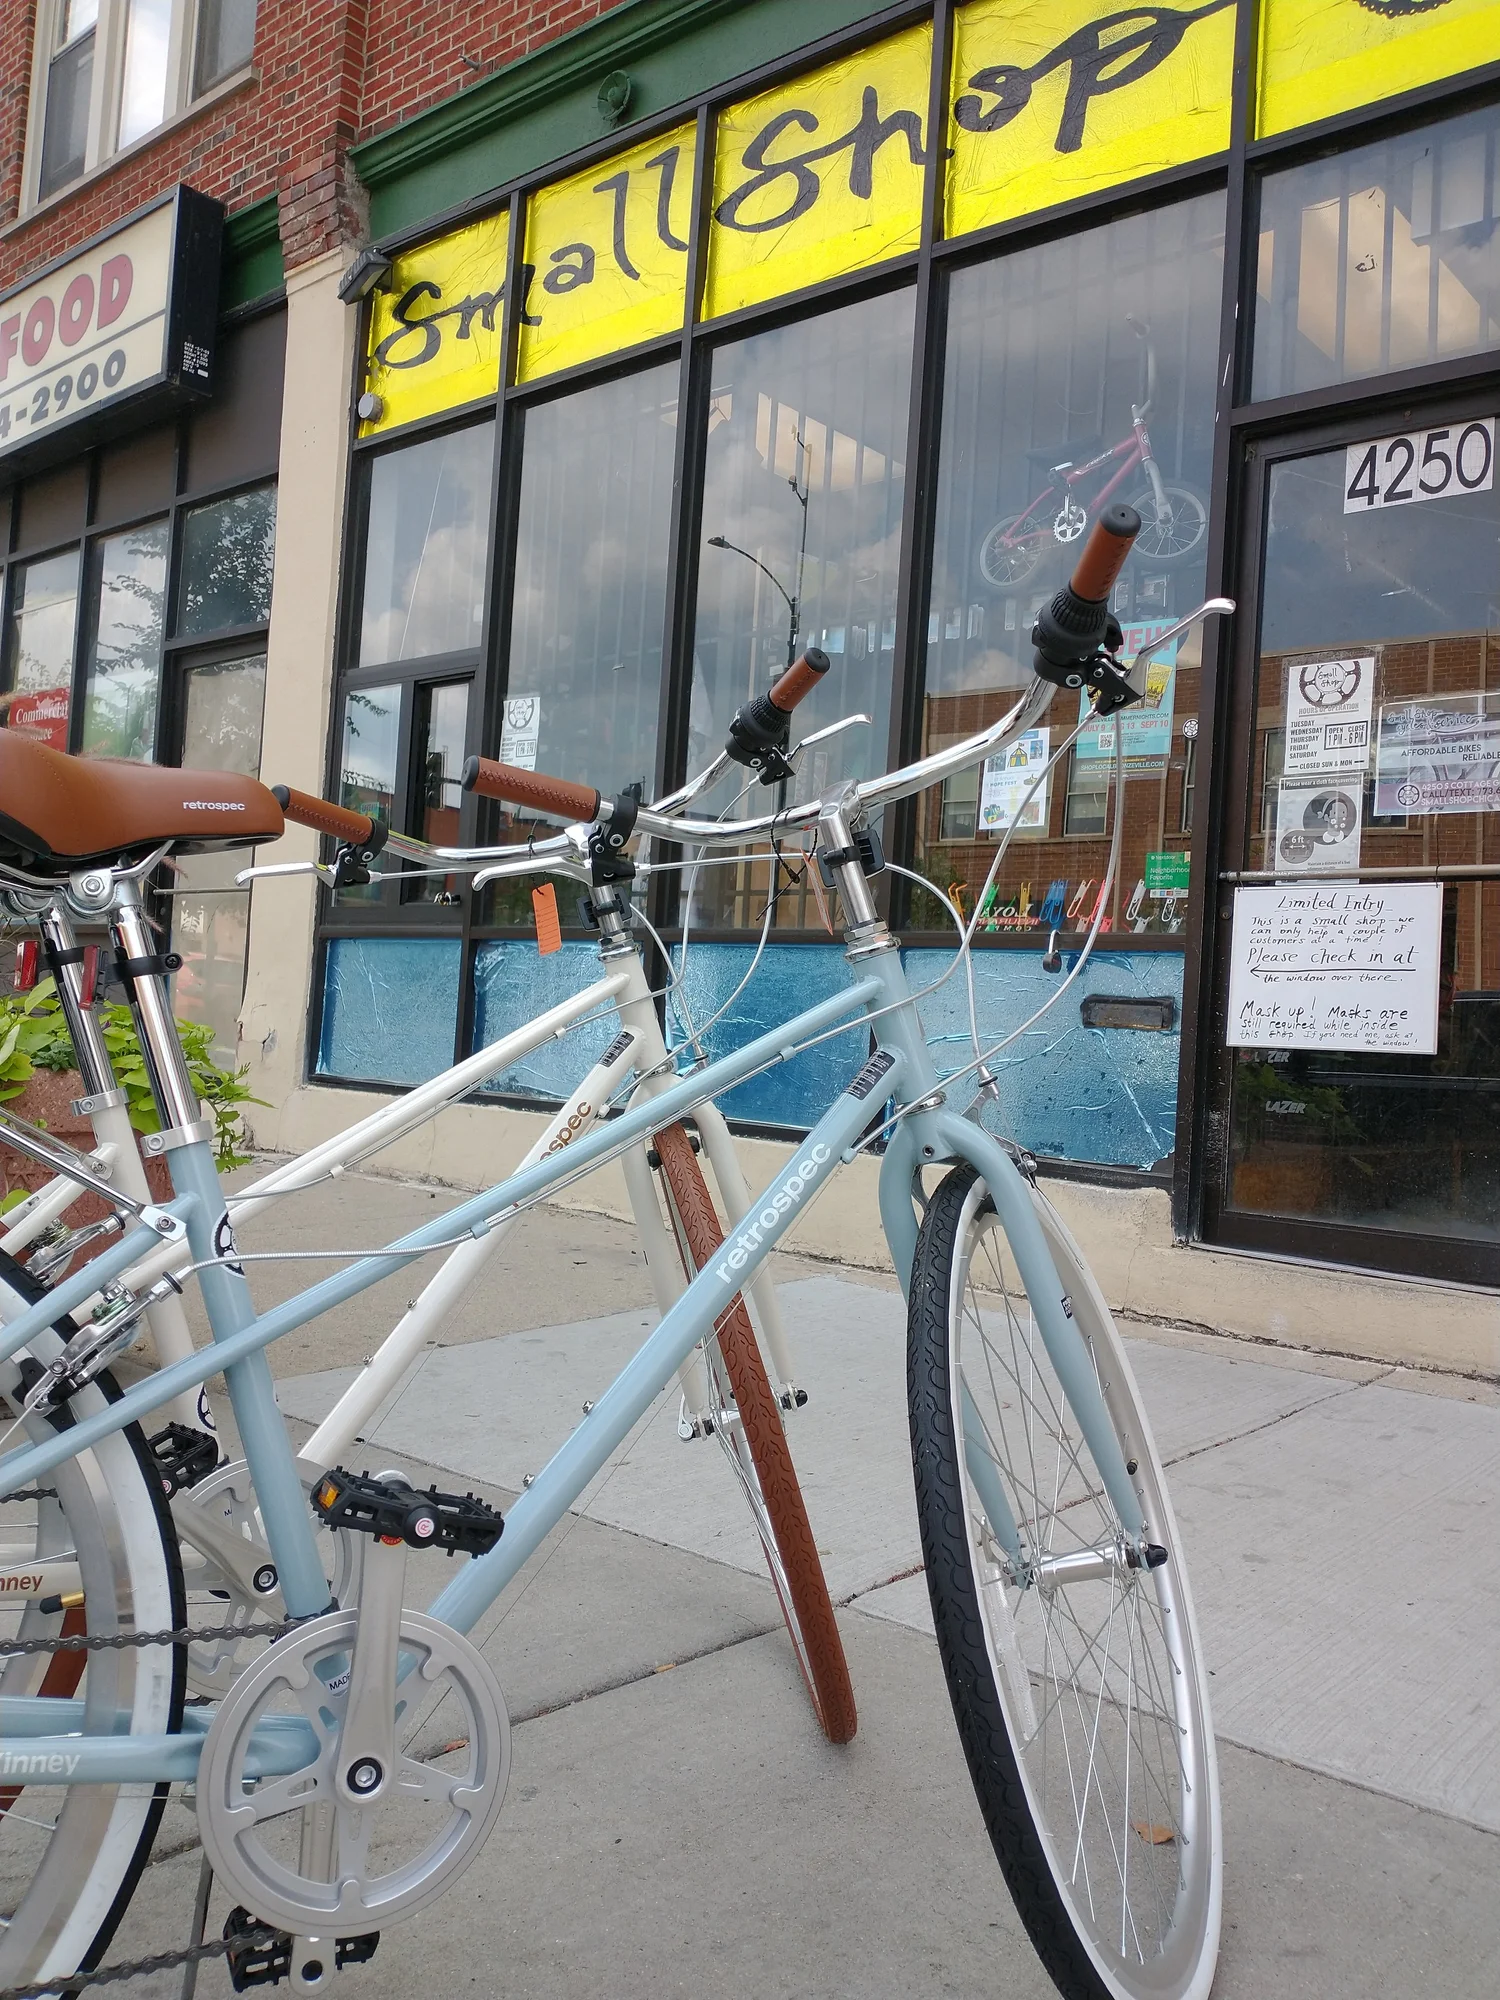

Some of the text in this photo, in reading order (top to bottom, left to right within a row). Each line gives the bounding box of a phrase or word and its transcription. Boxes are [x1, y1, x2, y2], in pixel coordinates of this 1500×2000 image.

[368, 0, 1237, 372] Small Shop
[0, 254, 133, 382] FOOD
[1347, 422, 1492, 506] 4250
[15, 700, 69, 724] Commercial
[1328, 703, 1360, 712] OPERATION
[1111, 722, 1124, 731] AG
[1140, 720, 1158, 728] SEPT
[1291, 720, 1316, 728] TUESDAY
[1348, 724, 1365, 732] CLOSE
[1290, 727, 1322, 736] WEDNESDAY
[1290, 735, 1320, 744] THURSDAY
[1290, 751, 1318, 760] SATURDAY
[1401, 744, 1482, 756] AFFORDABLE BIKES
[1300, 762, 1320, 770] CLOSED
[1450, 780, 1490, 788] COTTAGE
[1422, 788, 1474, 798] CALL/TEXT:
[182, 800, 246, 812] retrospec
[1298, 836, 1305, 844] ft
[1277, 892, 1384, 917] Limited Entry
[1252, 916, 1272, 926] This
[1280, 916, 1290, 925] is
[1312, 914, 1348, 926] small
[1280, 927, 1300, 937] only
[1308, 927, 1328, 938] help
[1353, 926, 1386, 938] couple
[1394, 924, 1408, 934] of
[1250, 936, 1306, 944] customers
[1247, 946, 1420, 964] Please check in at
[1264, 974, 1280, 984] the
[1286, 974, 1326, 983] window
[1240, 1000, 1280, 1020] Mask
[1380, 1008, 1408, 1020] are
[1241, 1019, 1398, 1031] still required while inside
[1240, 1030, 1259, 1039] this
[1304, 1030, 1318, 1039] If
[1319, 1032, 1336, 1041] you
[1340, 1030, 1358, 1038] need
[1266, 1100, 1306, 1114] LAZER
[715, 1143, 831, 1284] retrospec
[0, 1751, 82, 1776] inney
